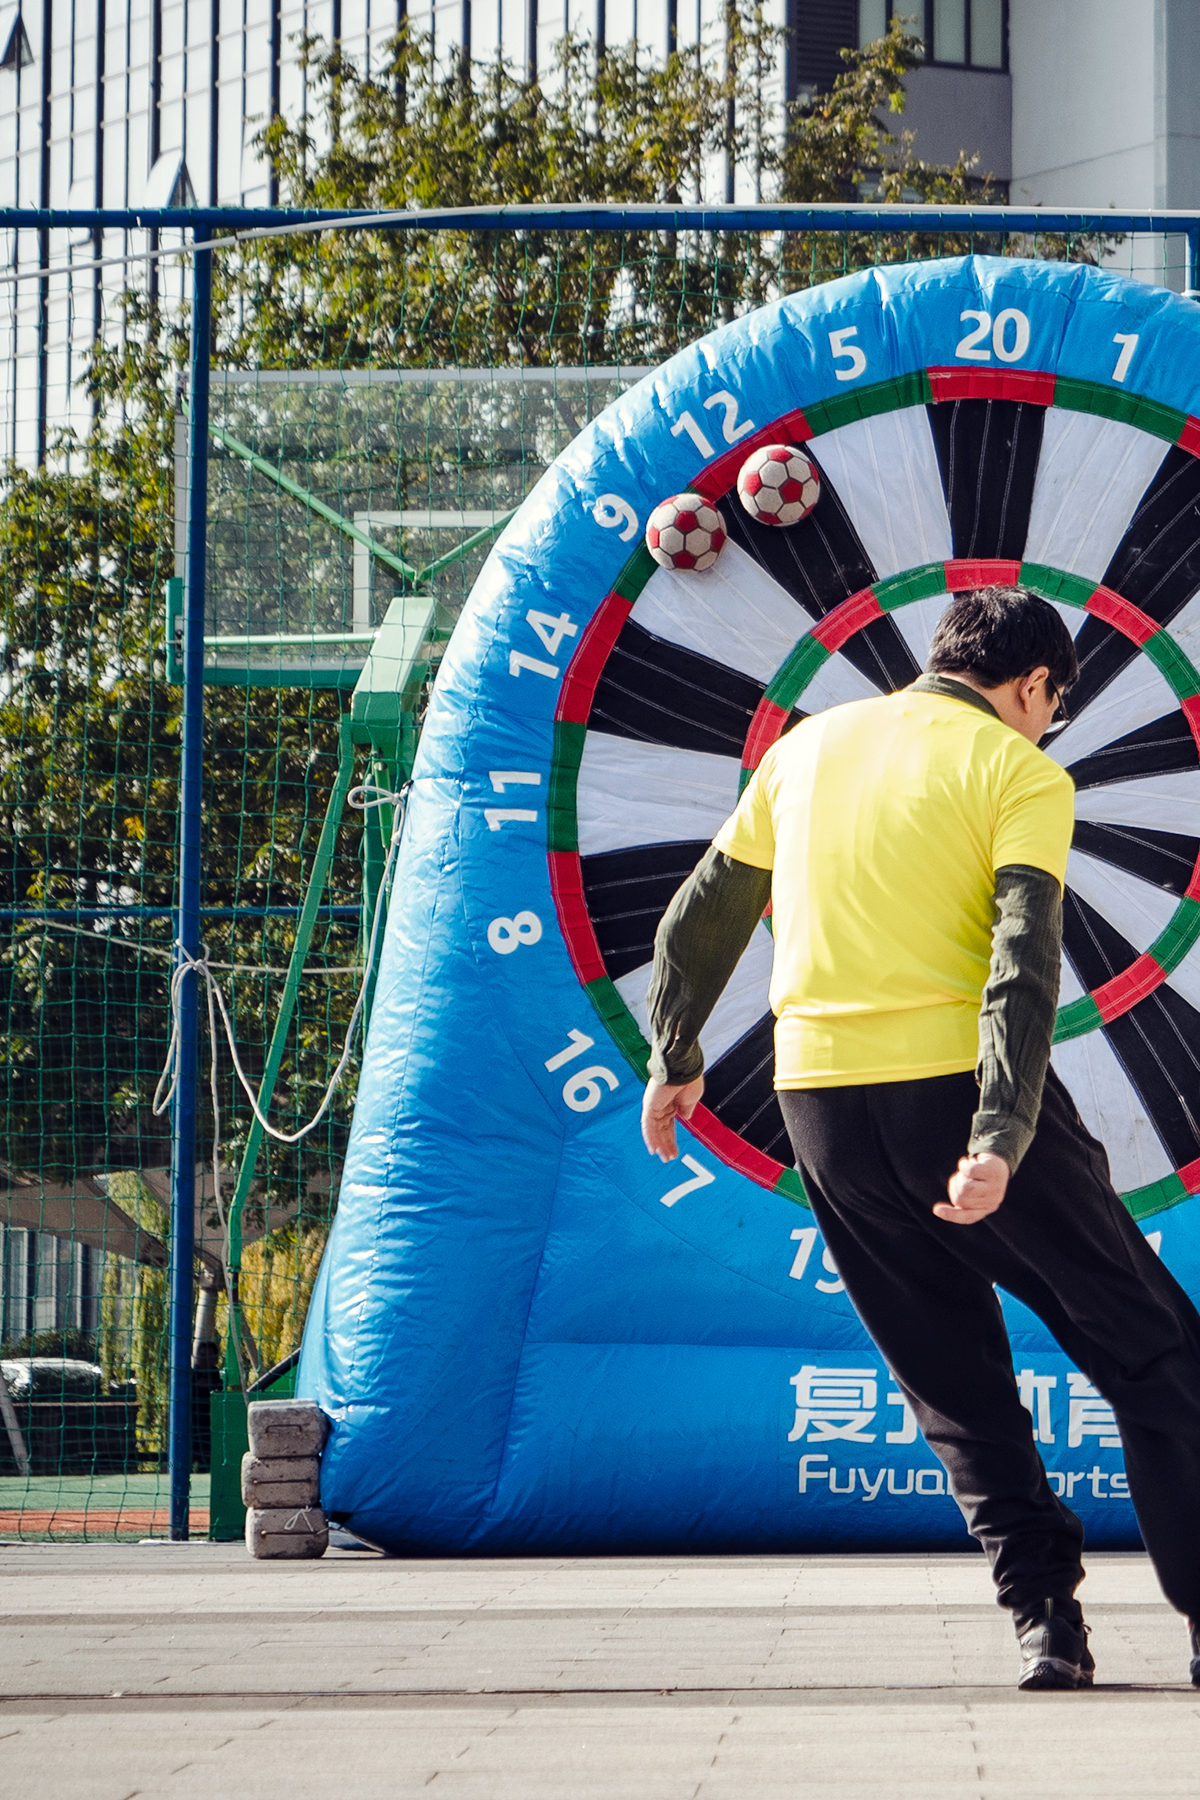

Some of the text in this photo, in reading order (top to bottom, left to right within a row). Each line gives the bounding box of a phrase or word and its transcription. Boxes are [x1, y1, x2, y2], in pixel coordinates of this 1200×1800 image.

[828, 326, 867, 381] 5
[956, 308, 1030, 362] 20
[1112, 333, 1139, 383] 1
[670, 389, 755, 459] 12
[591, 493, 639, 542] 9
[509, 608, 578, 679] 14
[483, 770, 541, 832] 11
[487, 910, 542, 955] 8
[544, 1029, 619, 1113] 16
[660, 1154, 715, 1207] 7
[798, 1454, 1131, 1501] Fuyua orts
